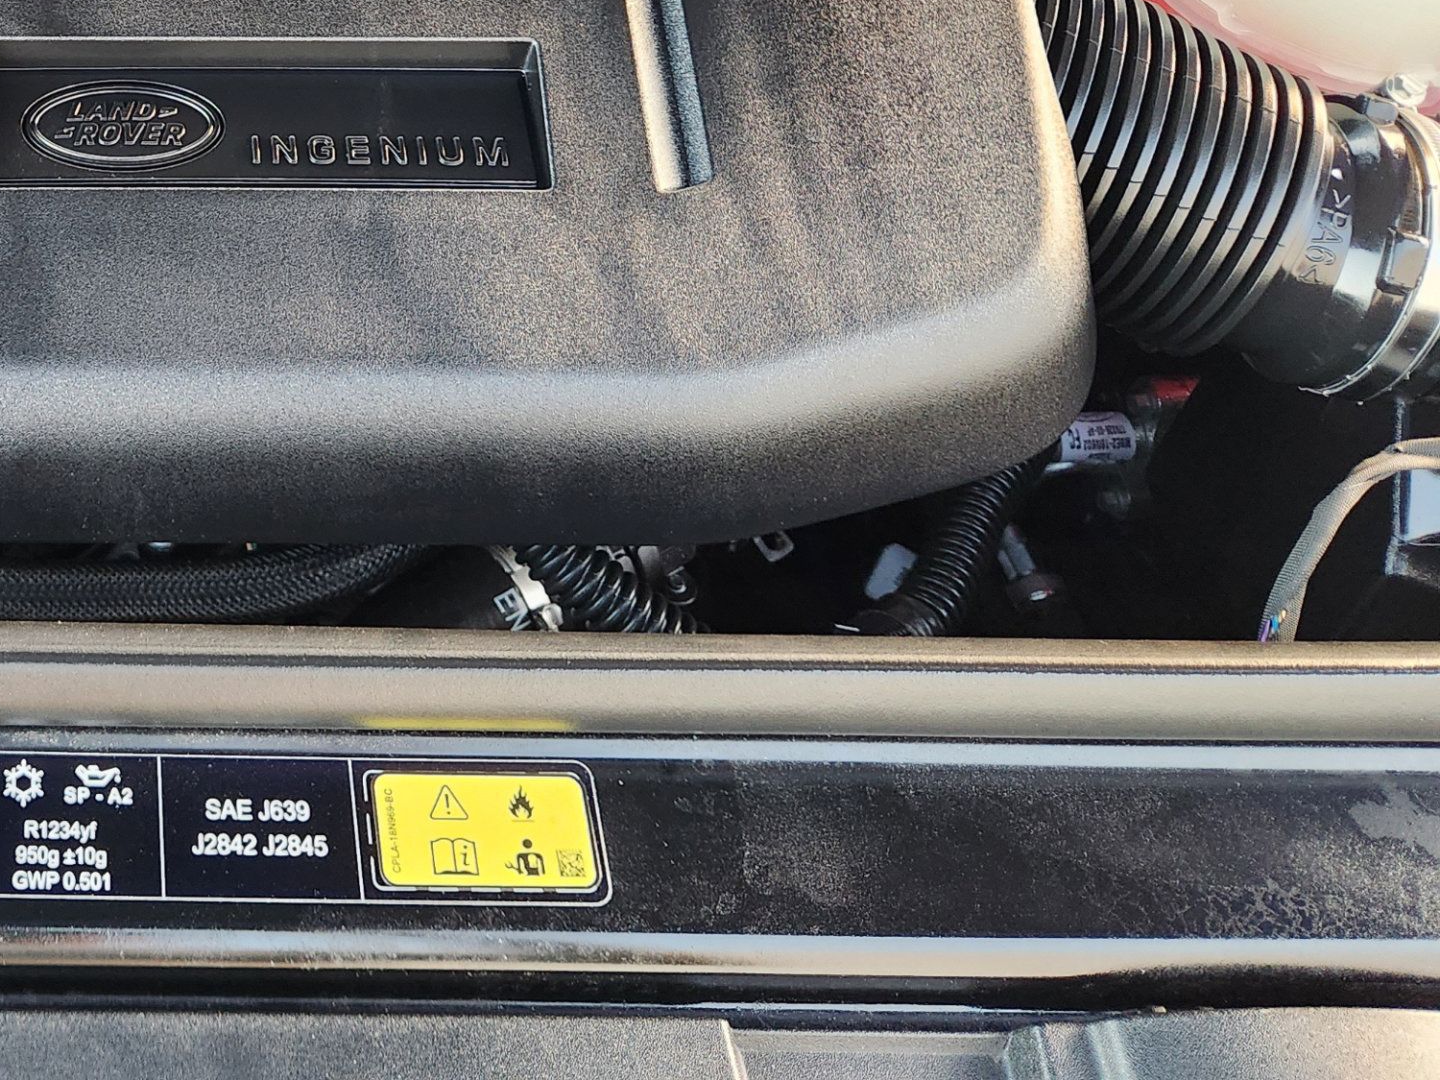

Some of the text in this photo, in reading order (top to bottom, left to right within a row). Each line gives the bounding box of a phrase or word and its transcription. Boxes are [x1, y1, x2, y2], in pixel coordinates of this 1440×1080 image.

[65, 98, 162, 122] LAND
[71, 121, 187, 148] ROVER
[250, 134, 511, 168] INGENIUM
[63, 786, 90, 805] SP
[107, 786, 134, 806] A2
[204, 798, 311, 823] SAE J639
[23, 819, 98, 844] R1234yf
[15, 845, 108, 869] 950g ±10g
[191, 832, 329, 858] J2842 J2845
[11, 870, 111, 891] GWP 0.501
